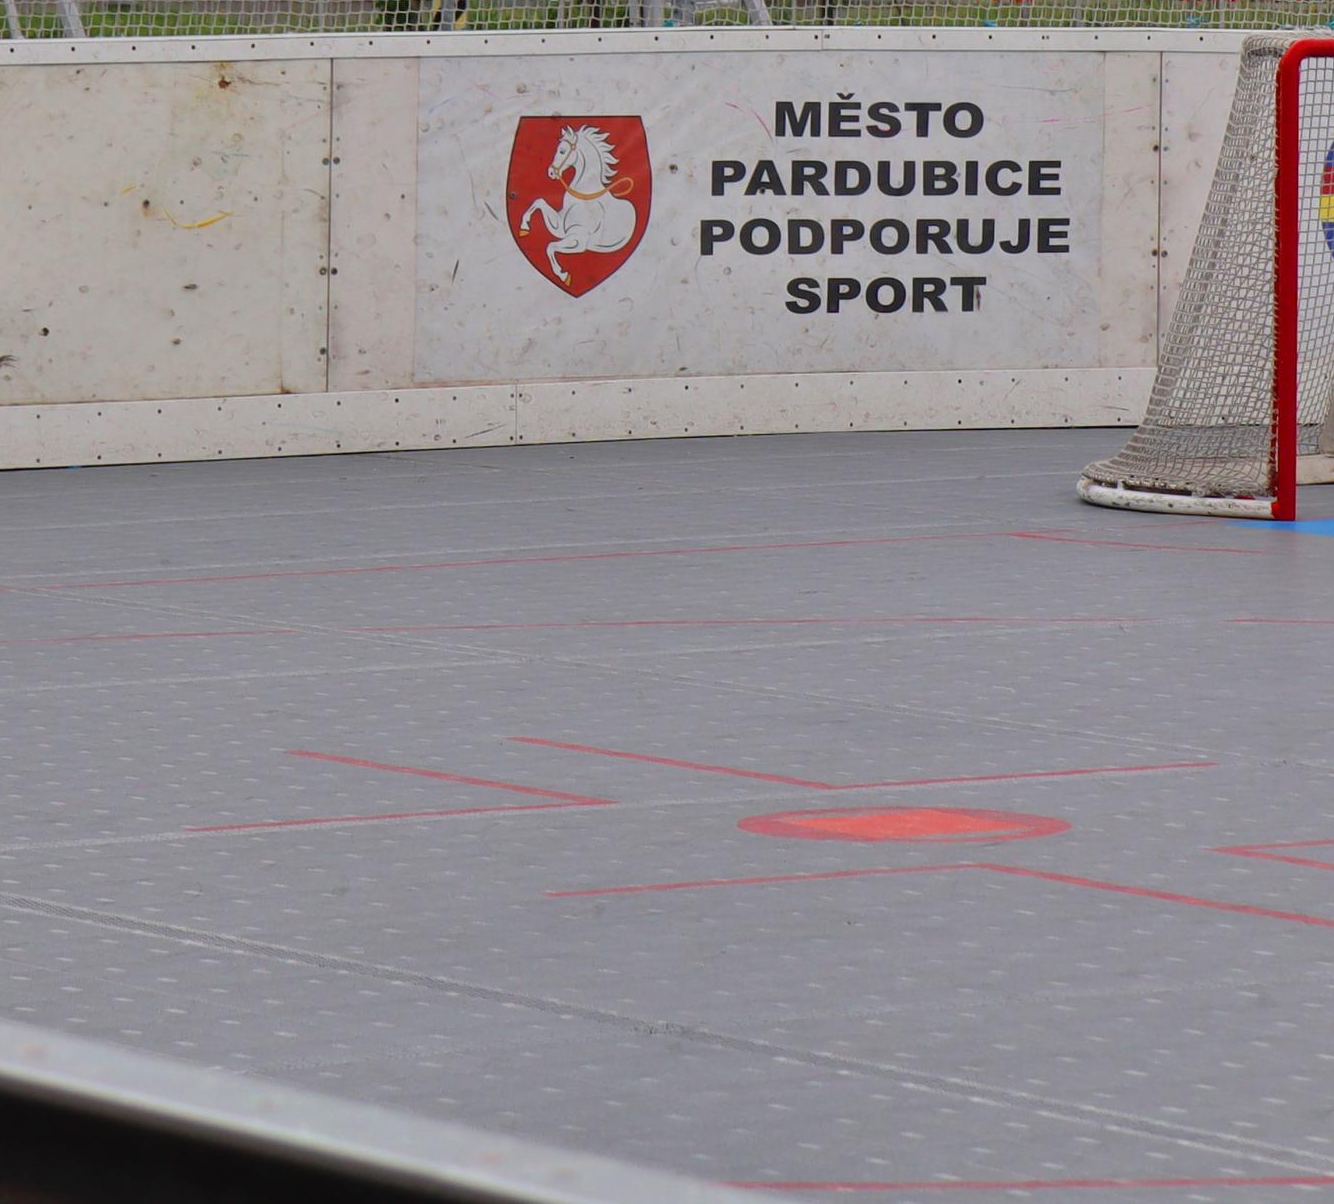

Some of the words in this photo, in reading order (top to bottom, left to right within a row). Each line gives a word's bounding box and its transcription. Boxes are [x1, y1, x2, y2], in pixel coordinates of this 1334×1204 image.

[774, 92, 985, 139] MĚSTO
[711, 159, 1063, 197] PARDUBICE
[700, 217, 1071, 256] PODPORUJE
[785, 276, 987, 315] SPORT
